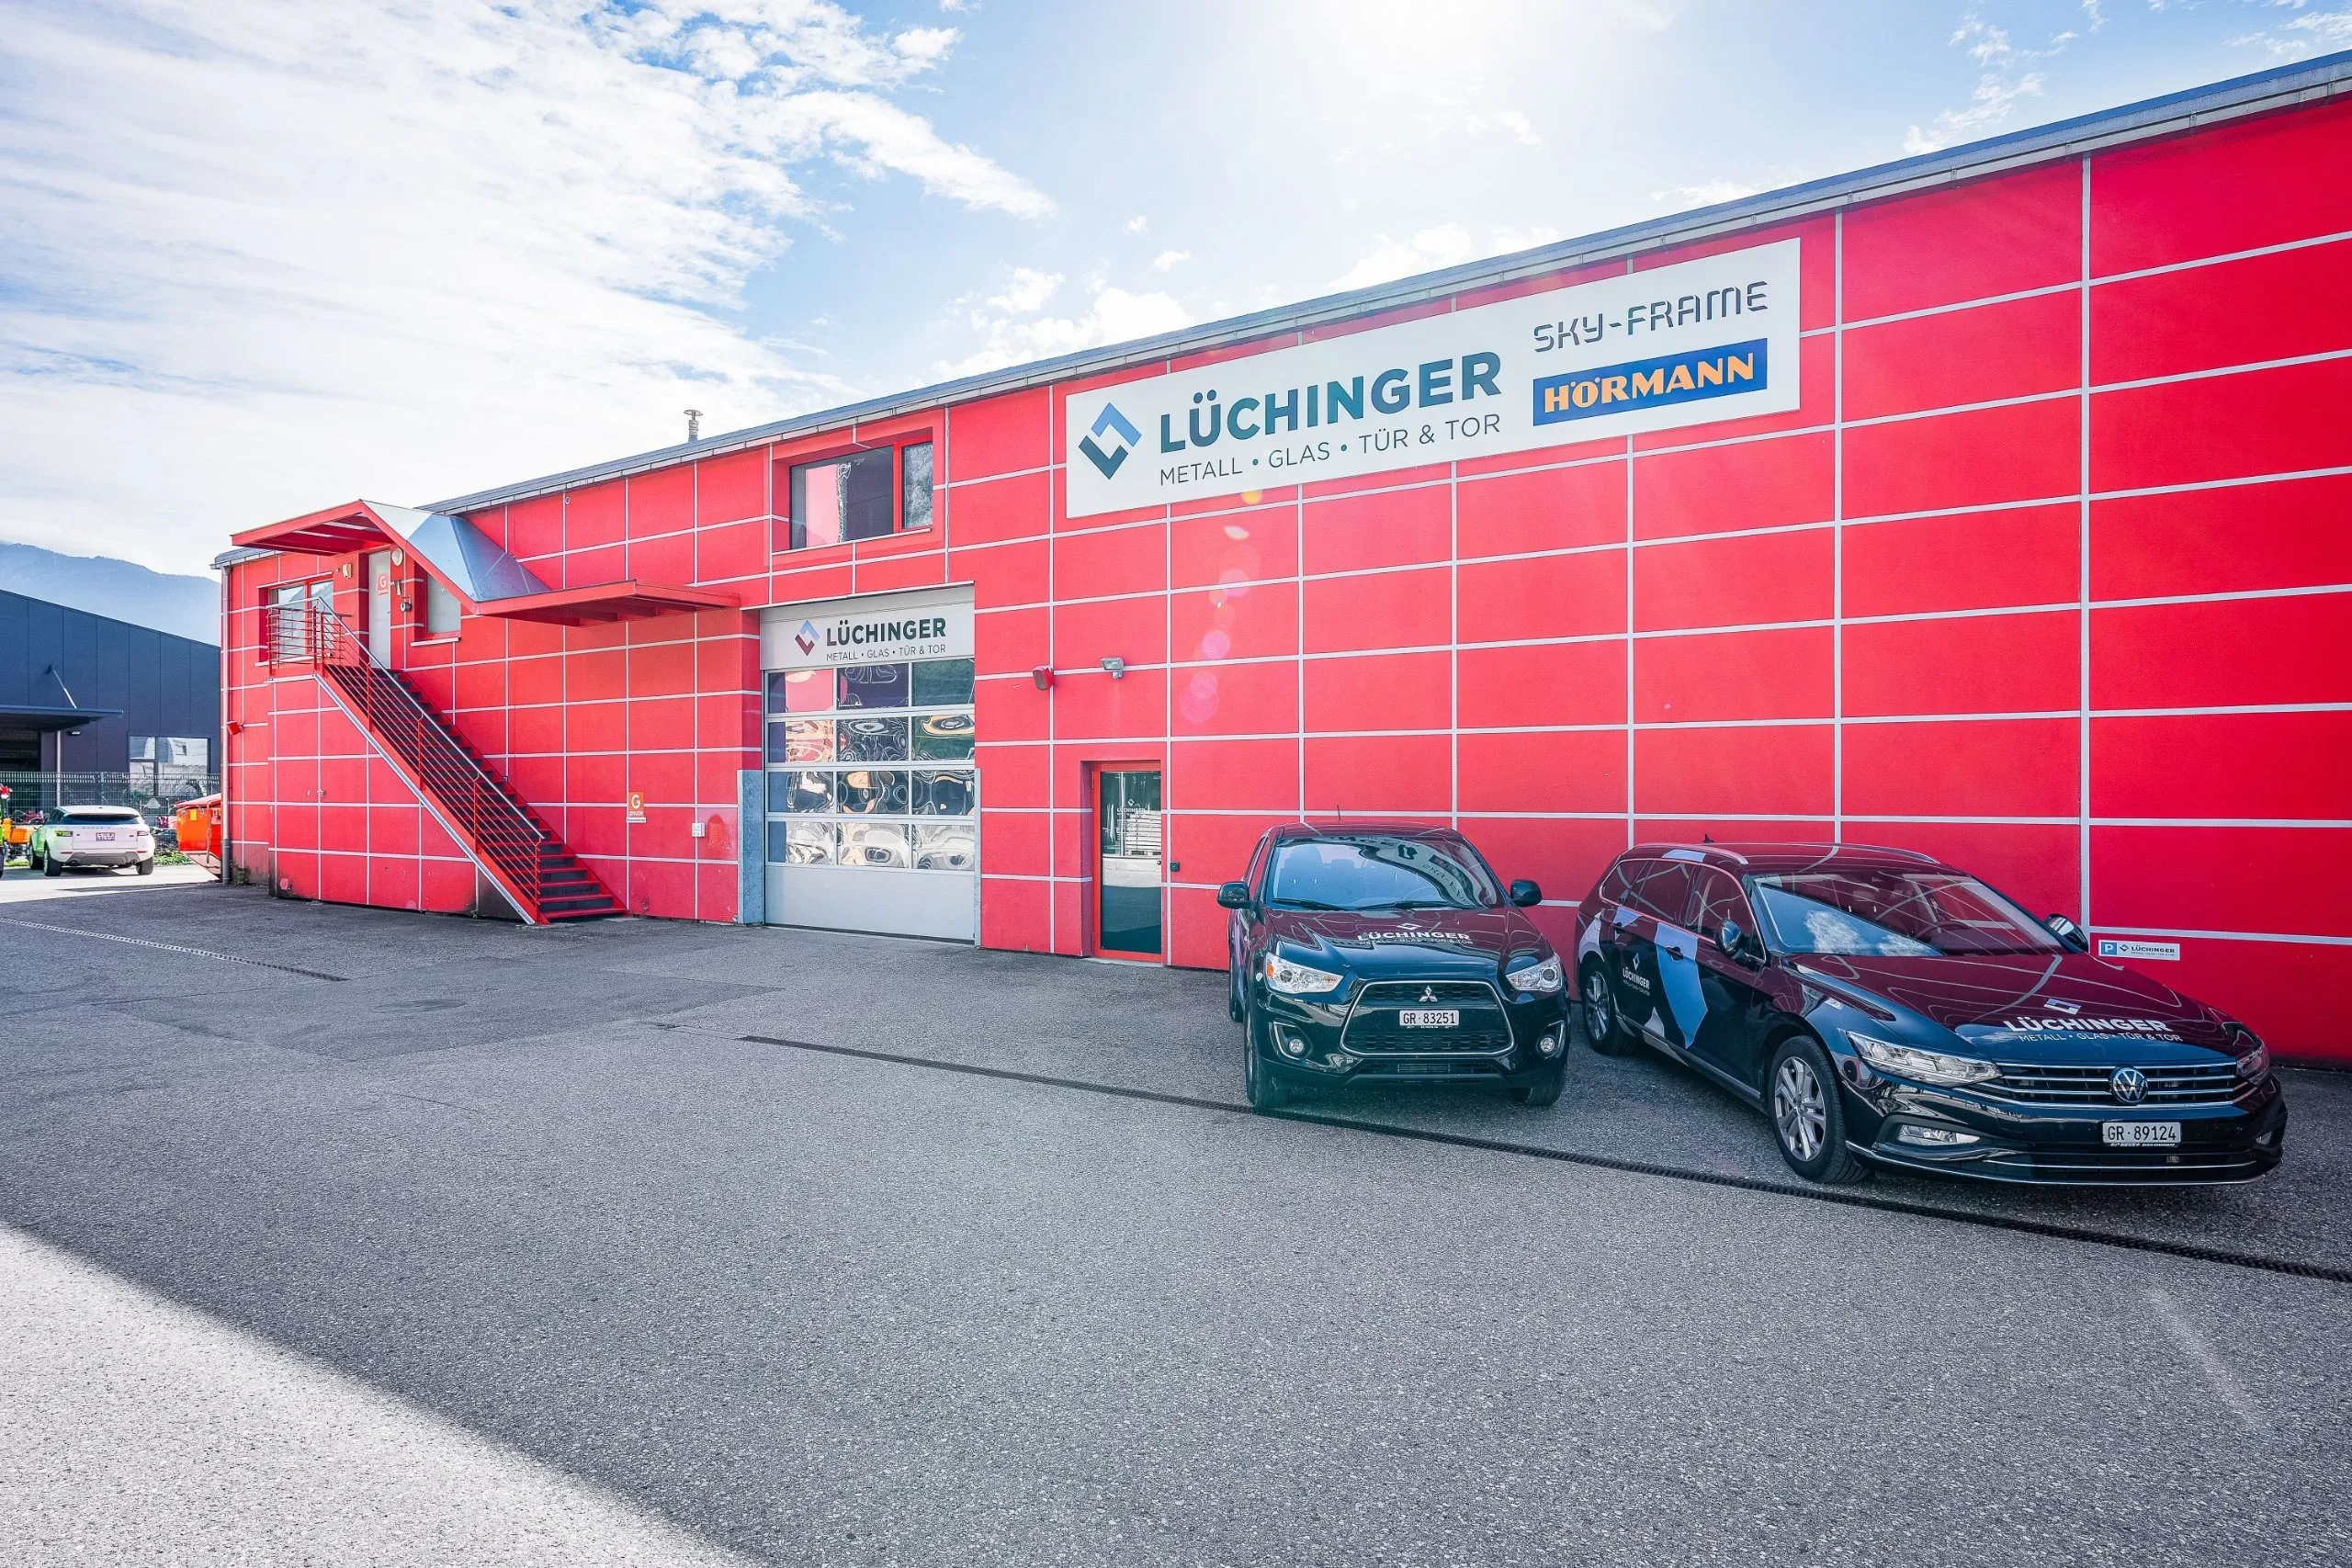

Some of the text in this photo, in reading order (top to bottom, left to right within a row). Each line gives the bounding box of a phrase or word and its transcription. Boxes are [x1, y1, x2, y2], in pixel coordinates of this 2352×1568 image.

[1533, 280, 1768, 353] SKY-FRAME
[1544, 352, 1754, 413] HÖRMANN
[1160, 351, 1502, 454] LÜCHINGER
[1160, 413, 1500, 486] METALL GLAS TÜR & TOR
[826, 617, 946, 647] LÜCHINGER
[826, 644, 946, 661] METALL GLAS TÜR & TOR
[631, 794, 641, 809] G
[1357, 931, 1472, 941] LÜCHINGER
[2104, 943, 2176, 953] P LÜCHINGER
[1403, 1013, 1455, 1024] GR 83251
[2003, 1016, 2173, 1032] LÜCHINGER
[2120, 1032, 2145, 1041] TÜR
[2108, 1126, 2176, 1141] GR 89124
